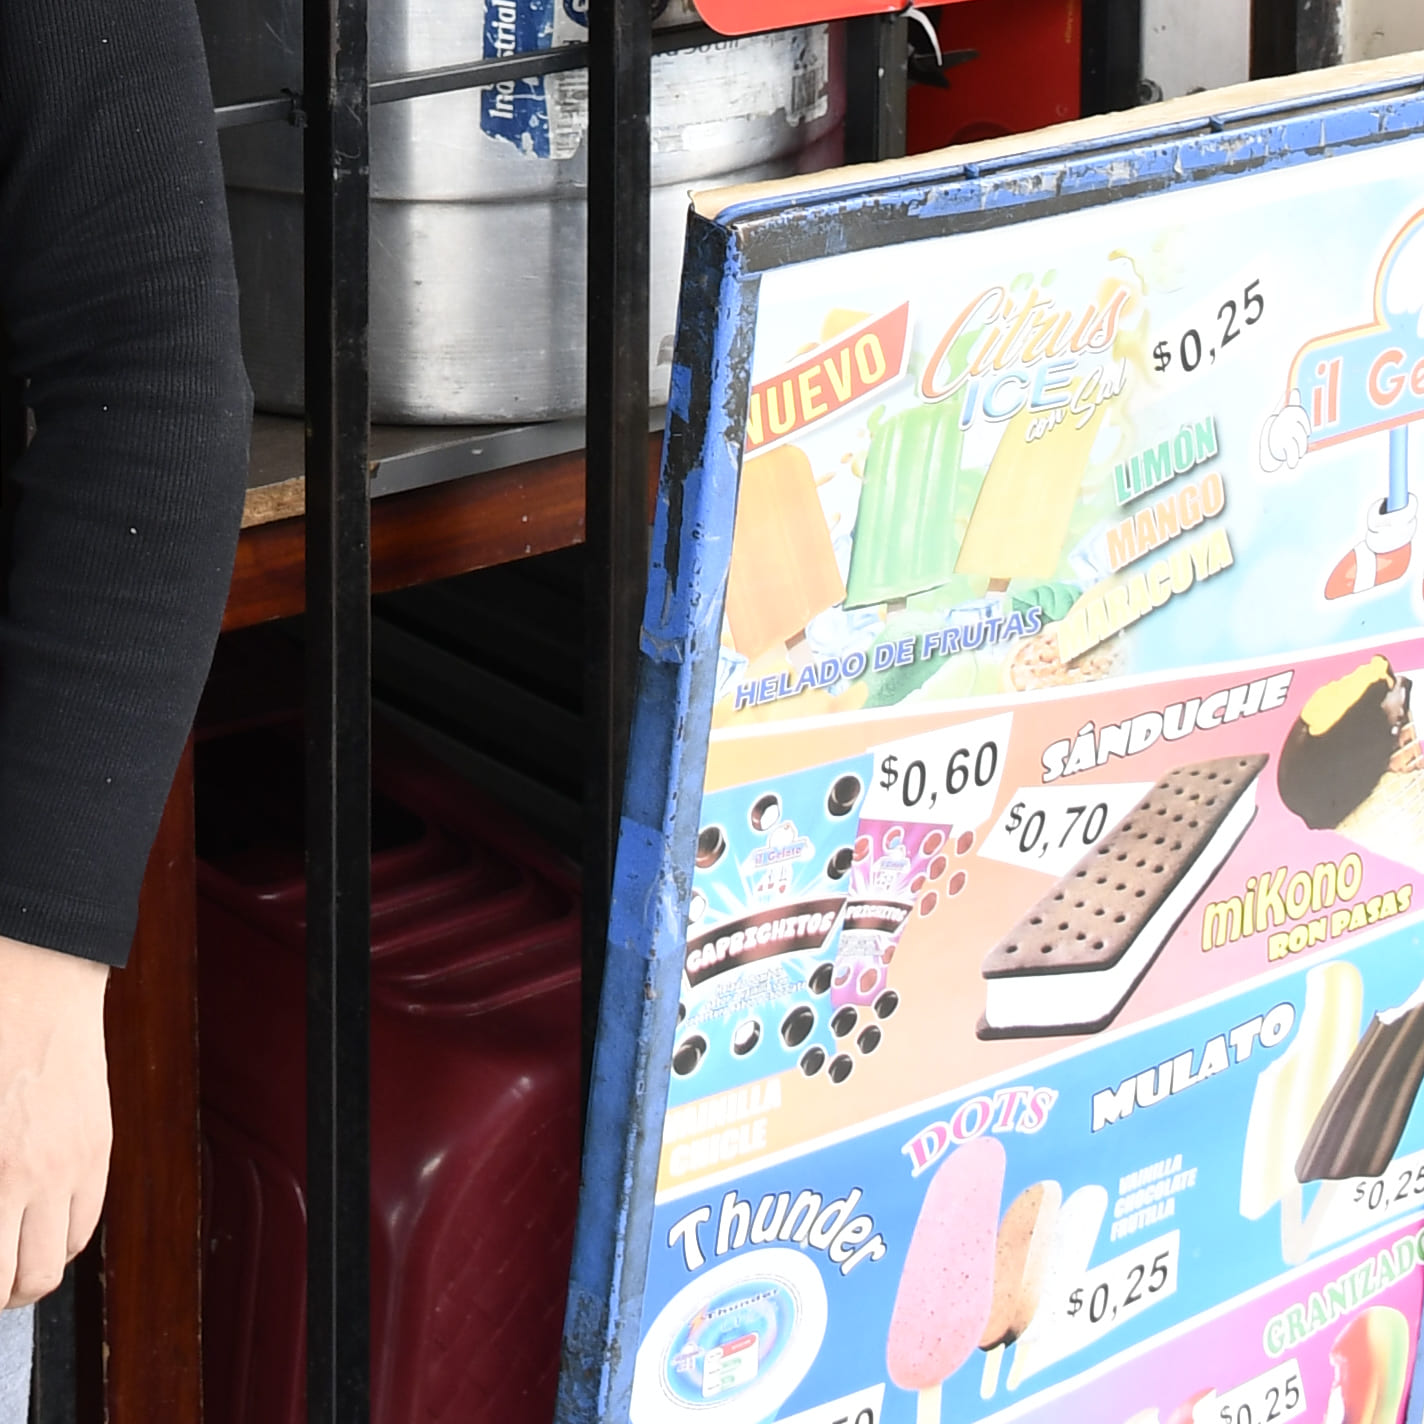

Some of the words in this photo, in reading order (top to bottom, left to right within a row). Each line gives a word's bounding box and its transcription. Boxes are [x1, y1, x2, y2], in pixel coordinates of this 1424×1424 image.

[920, 285, 1129, 403] Citrus
[1153, 278, 1265, 373] $0,25
[746, 333, 887, 445] NUEVO
[958, 358, 1078, 430] ICE
[1312, 356, 1344, 429] il
[1113, 414, 1218, 507] LIMÓN
[1105, 471, 1226, 574] MANGO
[733, 651, 866, 711] HELADO
[873, 637, 916, 672] DE
[921, 605, 1044, 660] FRUTAS
[1041, 671, 1295, 785] SÁNDUCHE
[879, 740, 998, 809] $0,60
[1004, 802, 1109, 856] $0,70
[685, 911, 836, 973] CAPRICHITOS
[845, 903, 909, 923] PRICHITOS
[1202, 853, 1364, 953] miKono
[1268, 920, 1327, 962] RON
[1330, 884, 1414, 942] PASAS
[1090, 1001, 1299, 1135] MULATO
[903, 1086, 1059, 1178] DOTS
[667, 1186, 888, 1277] Thunder
[1110, 1197, 1176, 1243] FRUTILLA
[1113, 1167, 1198, 1219] CHOCOLATE
[1066, 1250, 1170, 1324] $0,25
